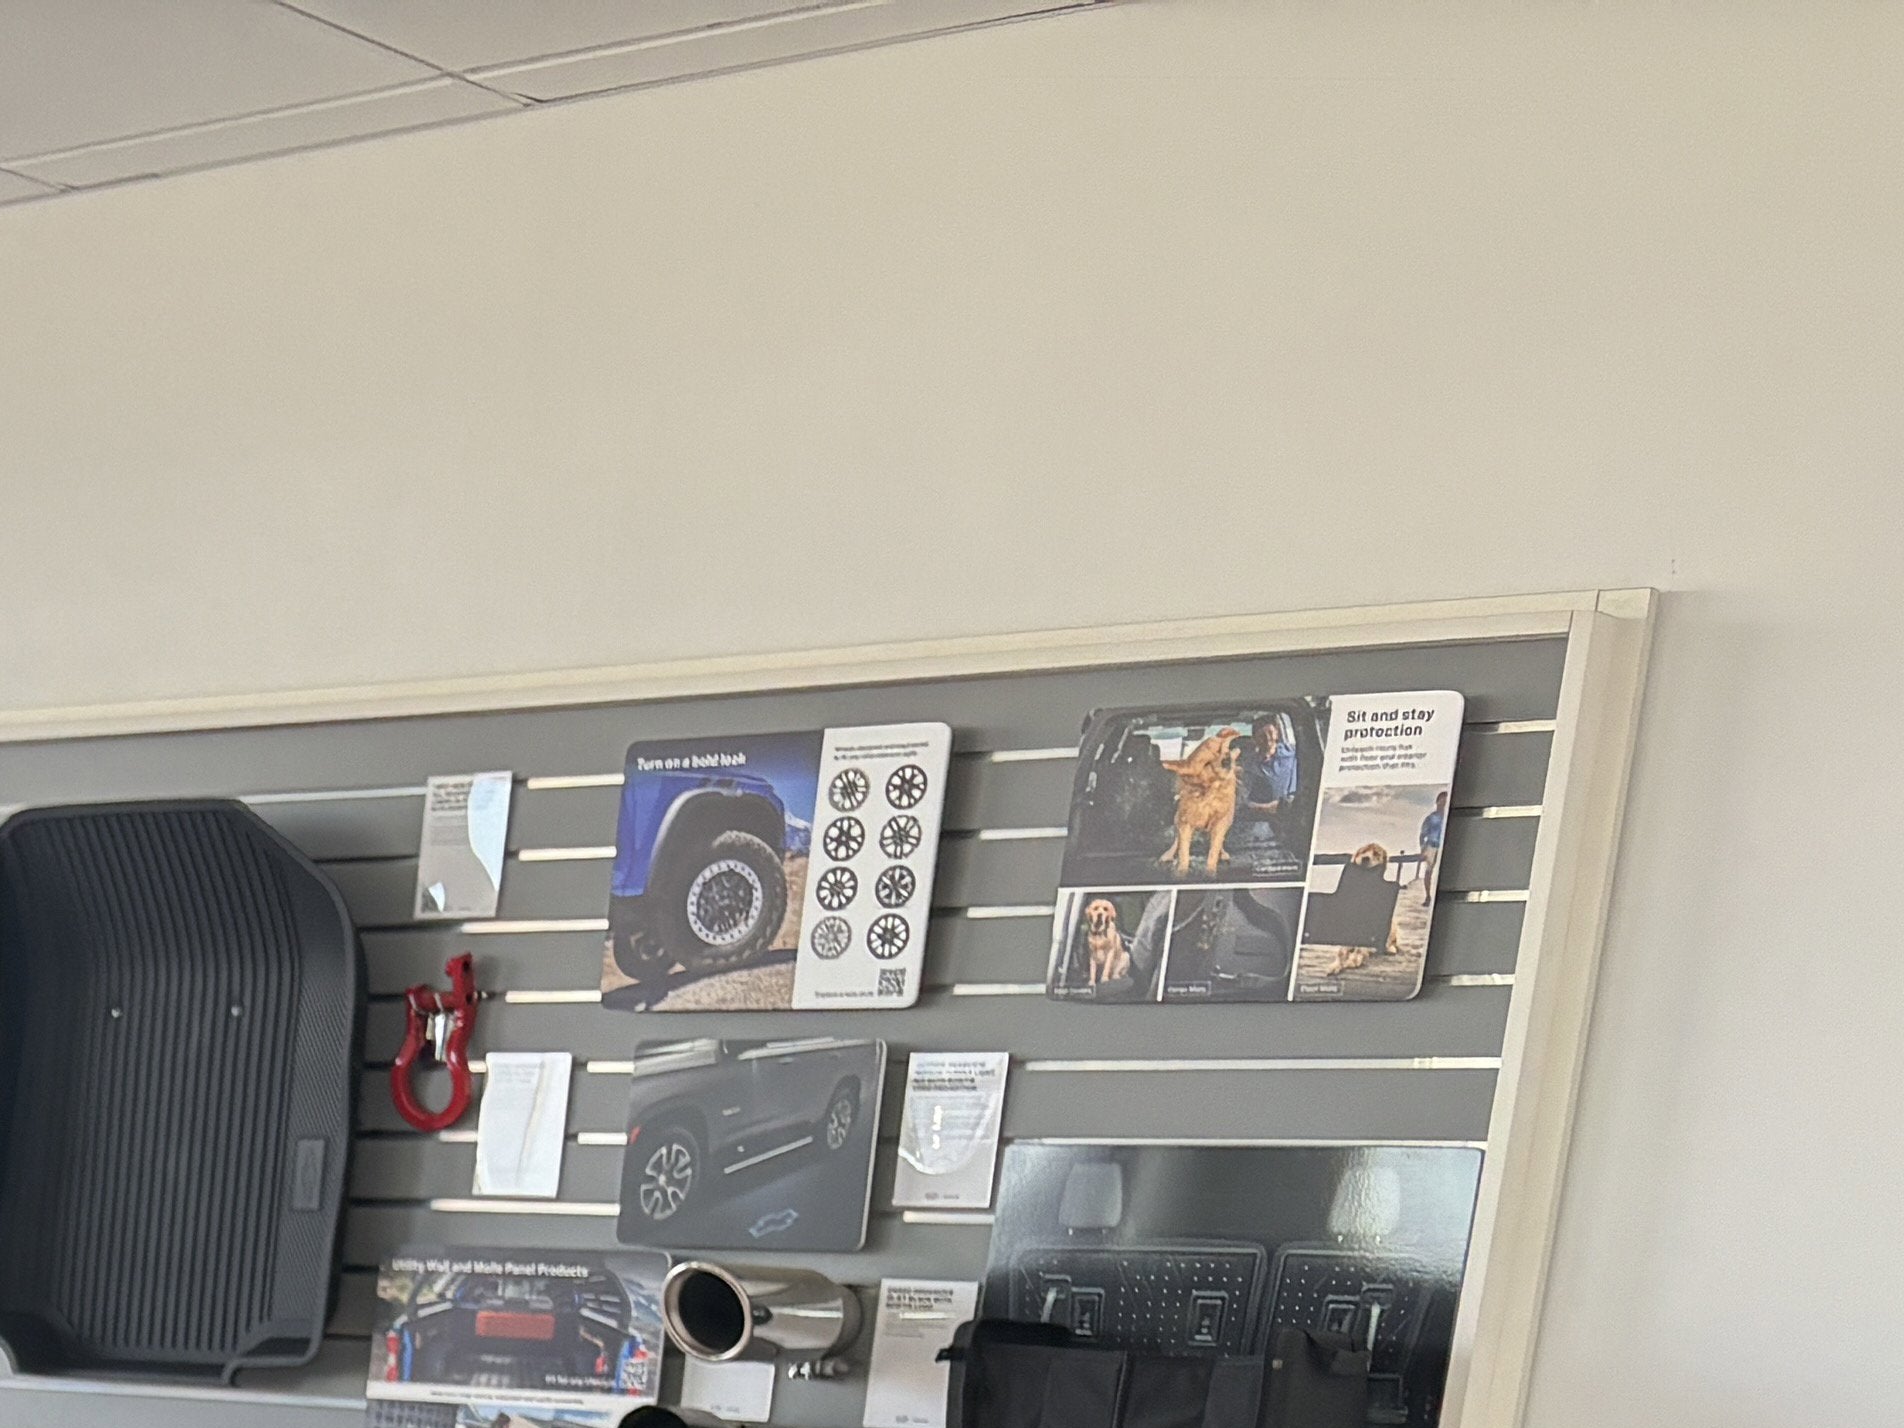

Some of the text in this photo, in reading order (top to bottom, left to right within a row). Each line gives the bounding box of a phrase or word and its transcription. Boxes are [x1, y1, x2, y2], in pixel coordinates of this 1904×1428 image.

[1347, 709, 1435, 723] Sit and stay
[1344, 724, 1423, 741] protection
[637, 757, 663, 770] Turn
[665, 758, 680, 769] on
[720, 752, 746, 766] look
[392, 1258, 588, 1278] Utility Wall and Molle Panel Products
